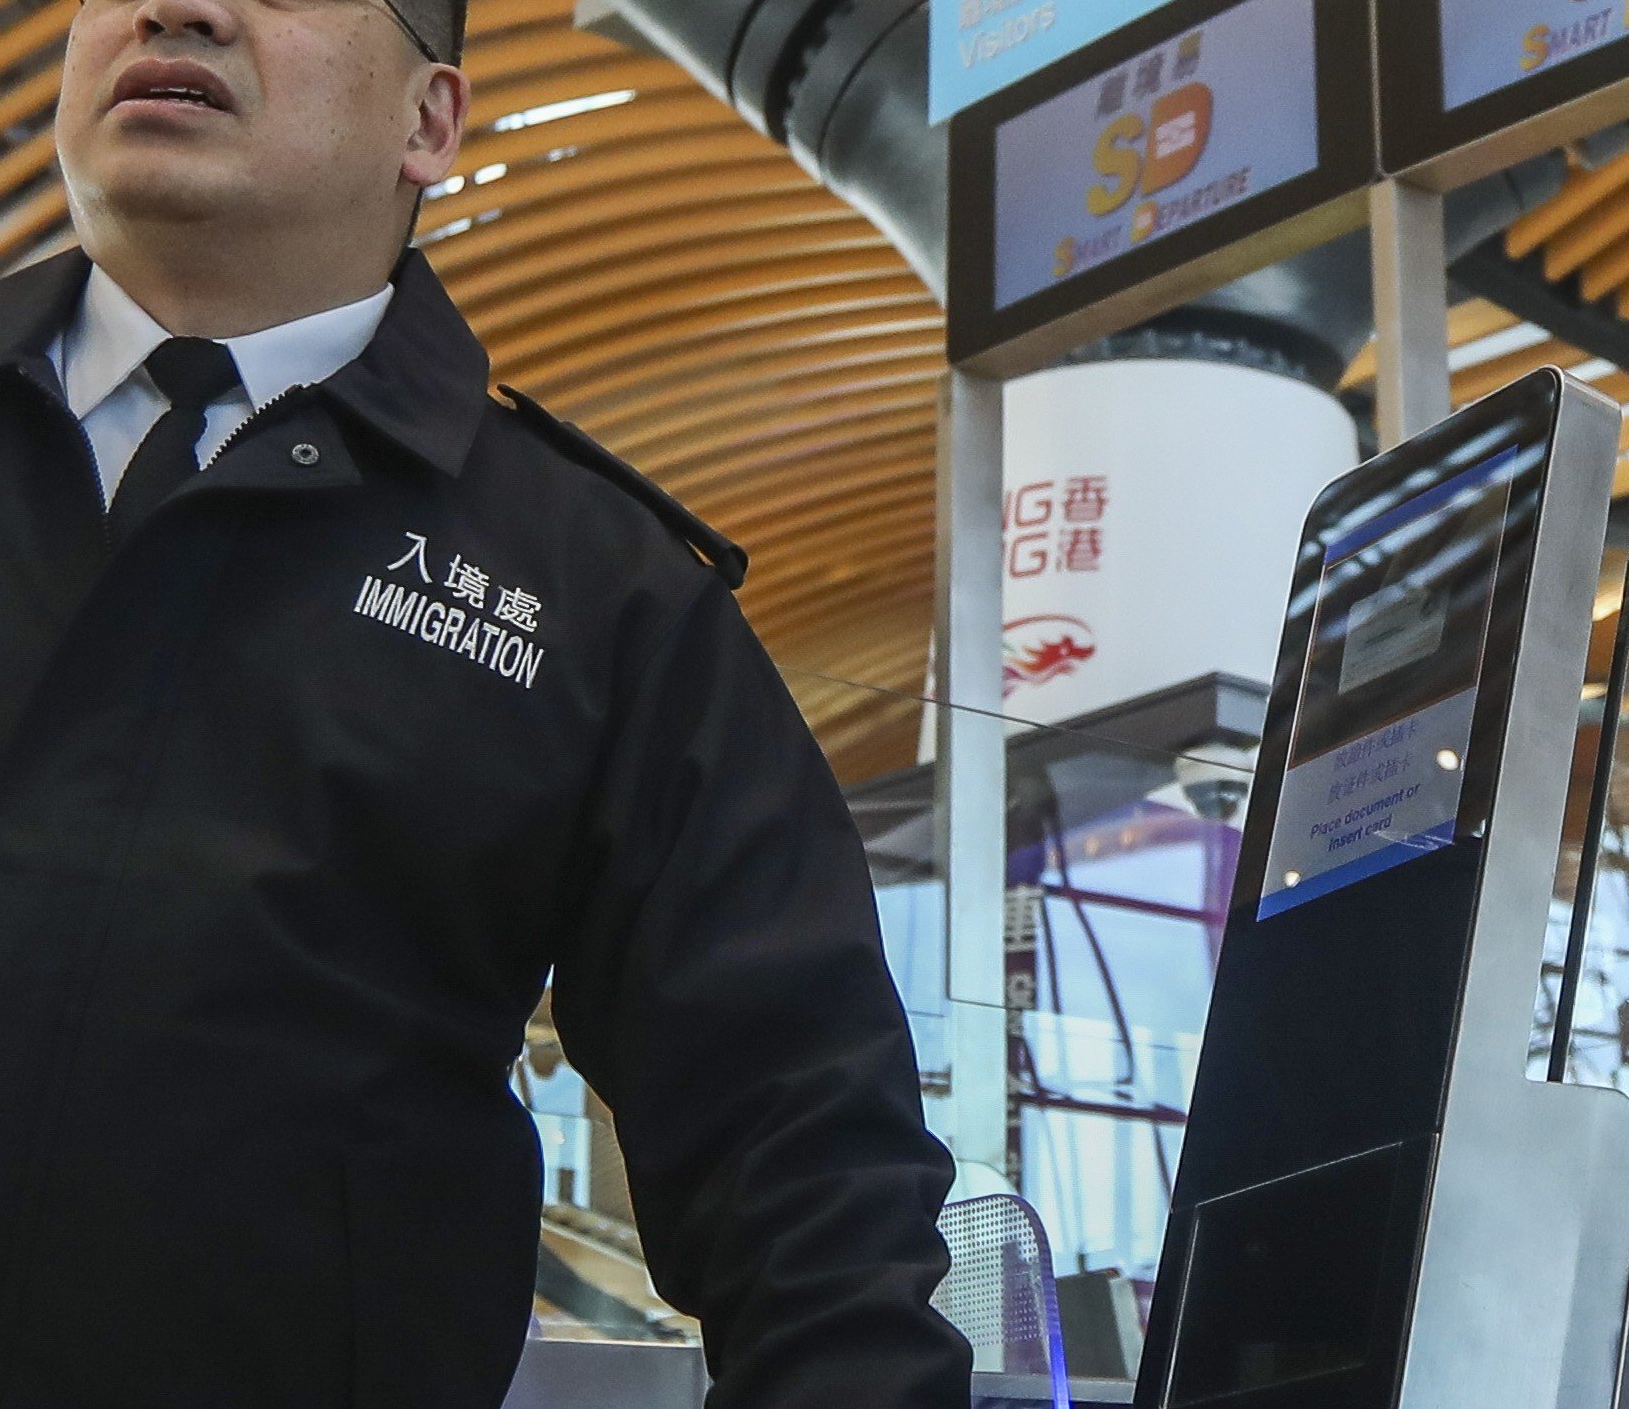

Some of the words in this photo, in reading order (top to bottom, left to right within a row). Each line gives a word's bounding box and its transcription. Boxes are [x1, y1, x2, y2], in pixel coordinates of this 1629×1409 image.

[1085, 81, 1214, 218] SD
[352, 575, 545, 689] IMMIGRATION
[386, 531, 542, 633] 入境處
[1310, 816, 1342, 840] Place
[1344, 790, 1405, 824] document
[1363, 813, 1393, 836] card
